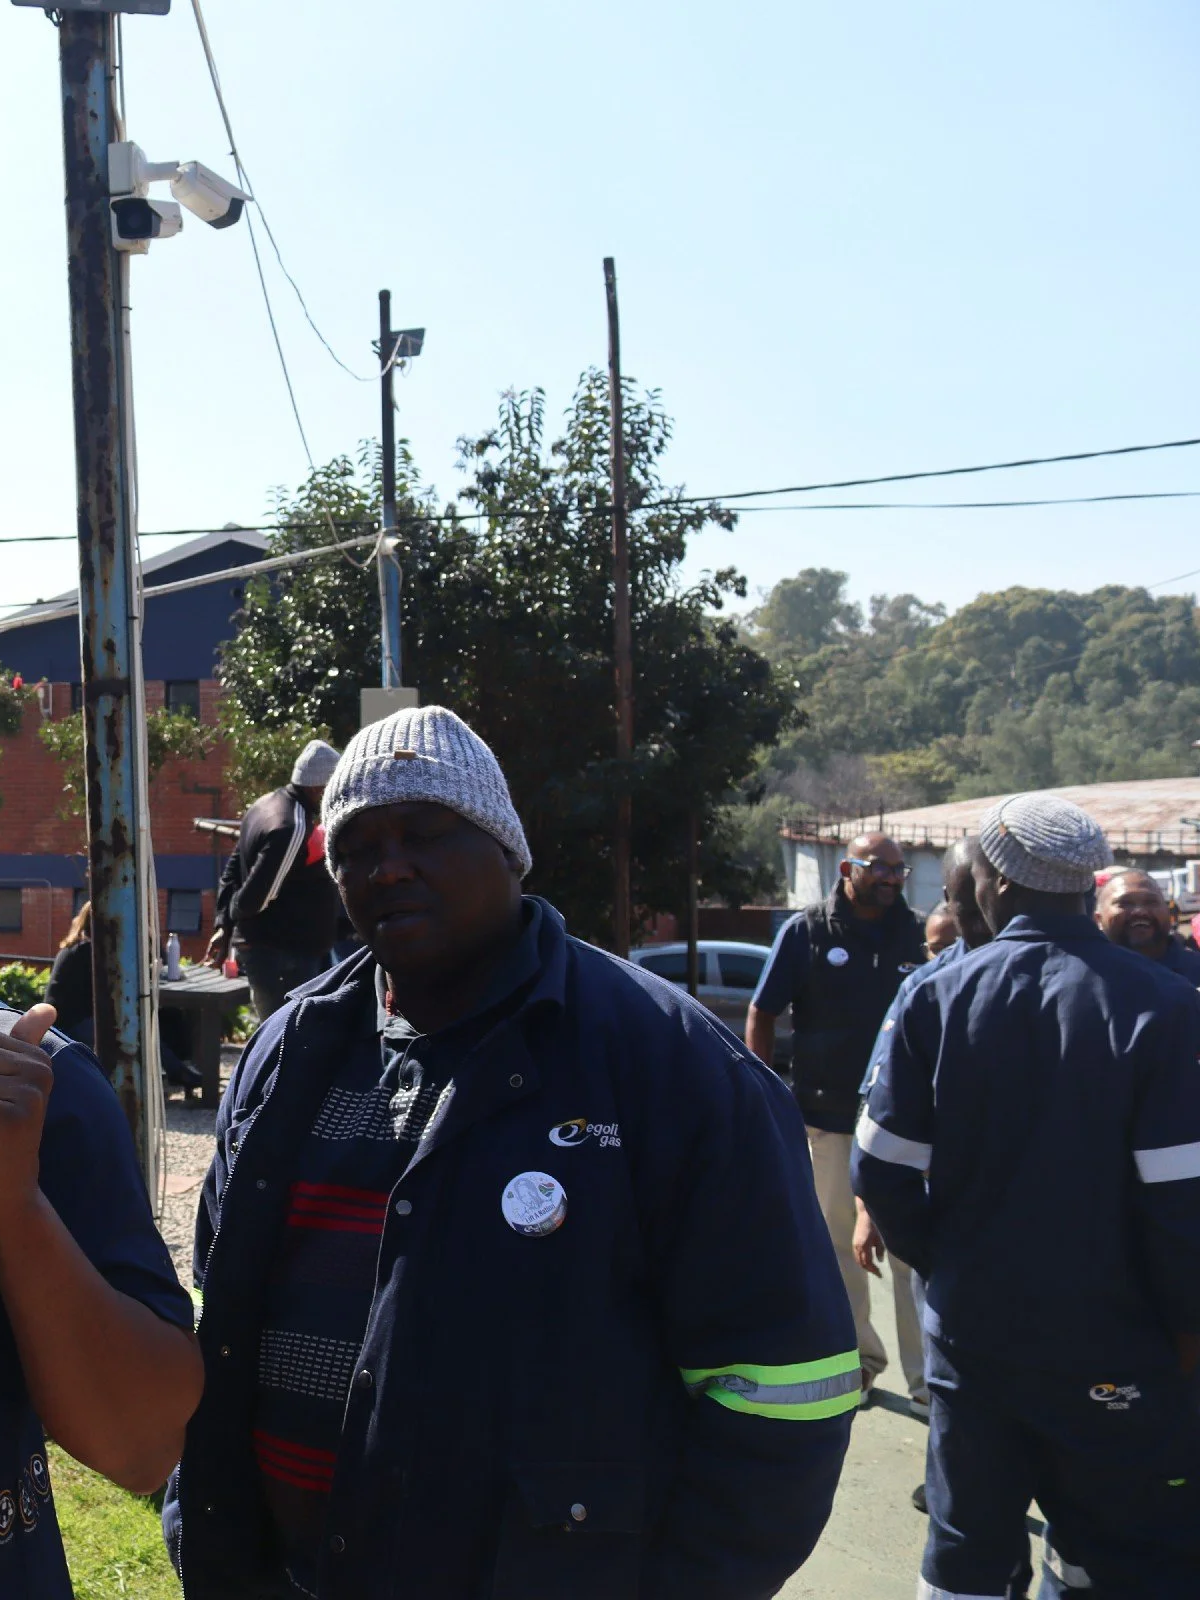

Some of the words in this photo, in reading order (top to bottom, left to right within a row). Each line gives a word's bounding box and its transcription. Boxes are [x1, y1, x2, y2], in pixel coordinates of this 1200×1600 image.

[586, 1123, 618, 1136] egoli
[599, 1135, 621, 1147] gas
[538, 1203, 556, 1217] Nation
